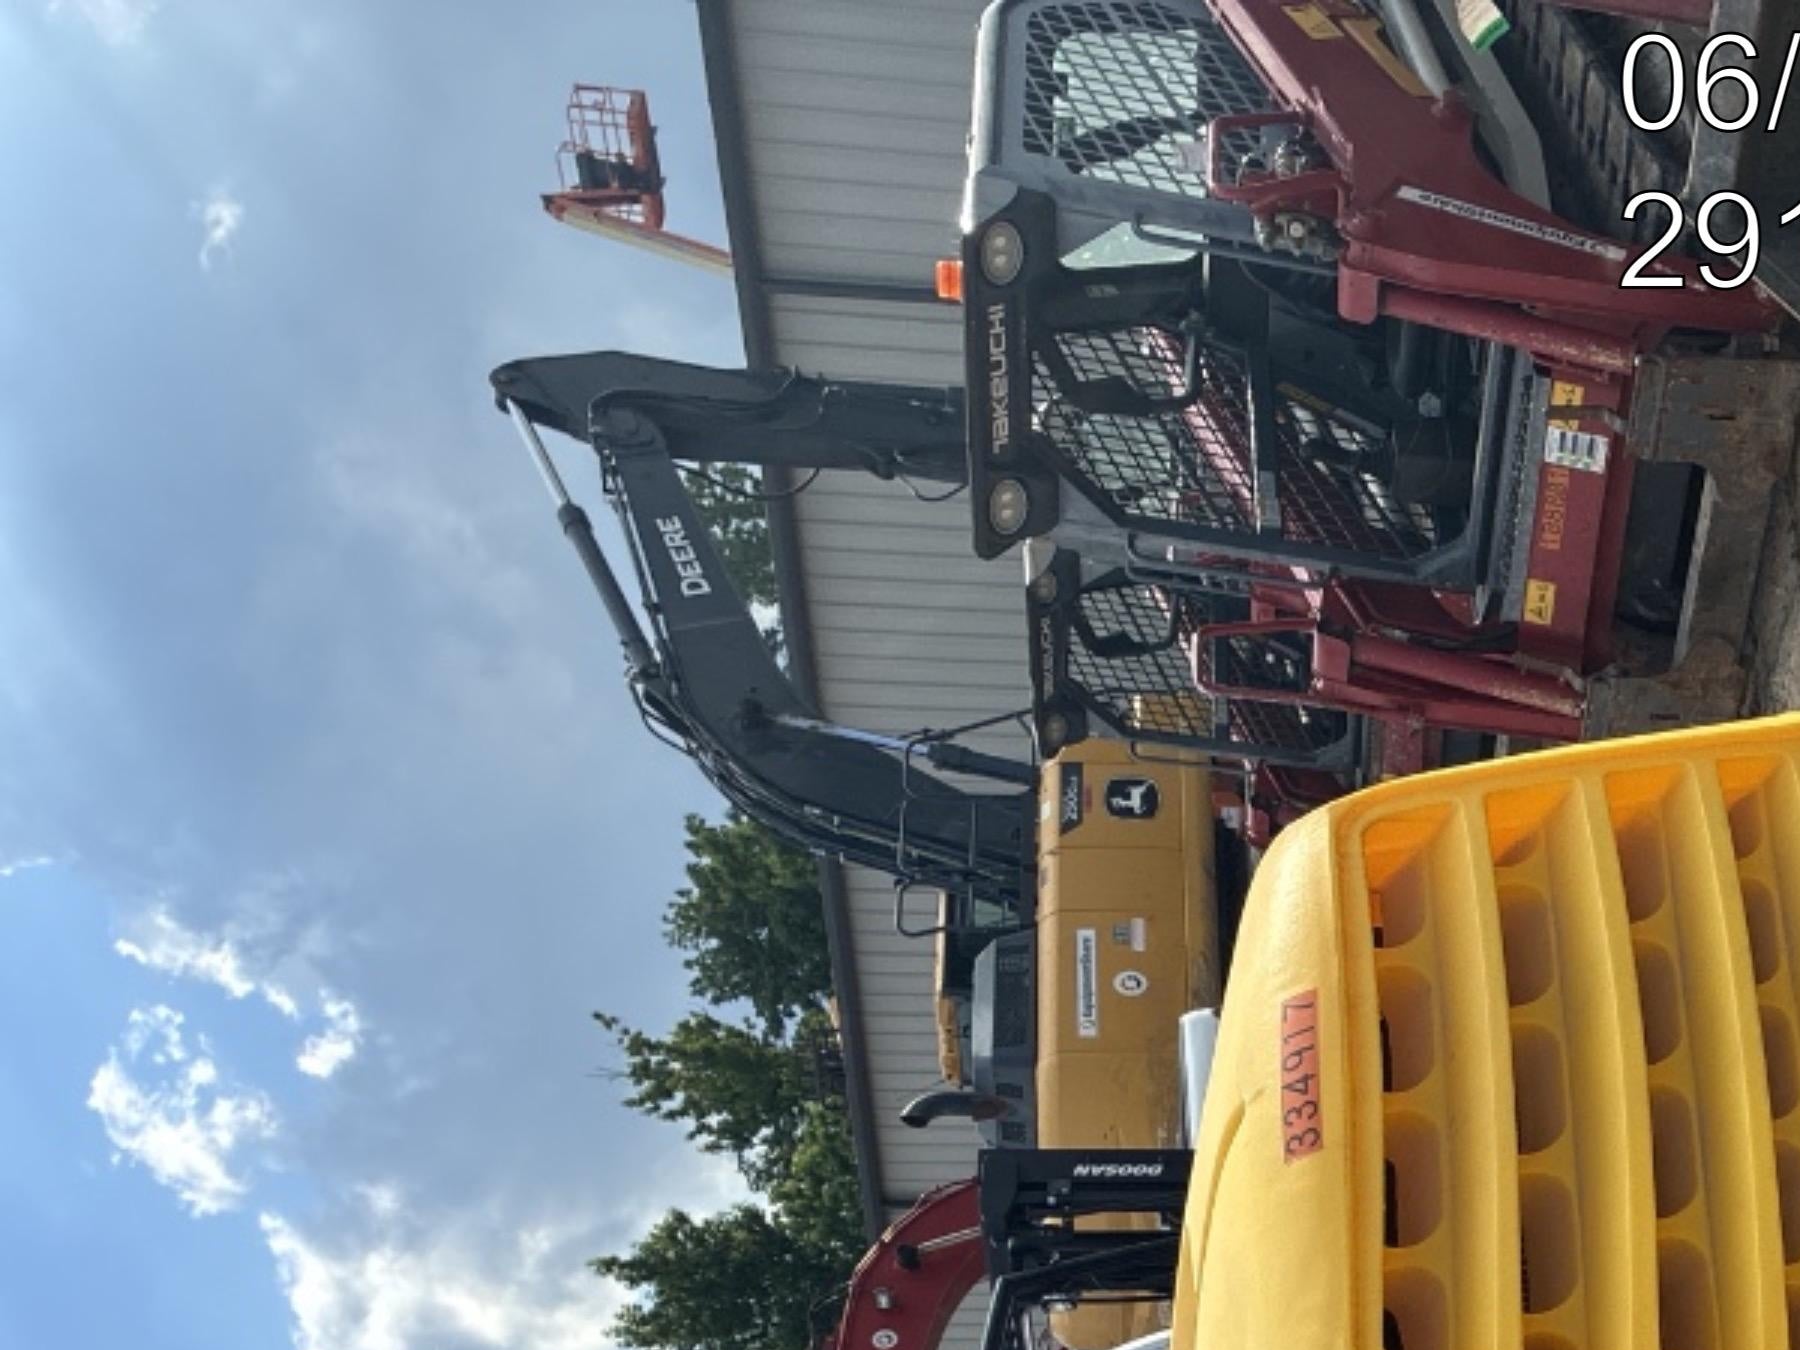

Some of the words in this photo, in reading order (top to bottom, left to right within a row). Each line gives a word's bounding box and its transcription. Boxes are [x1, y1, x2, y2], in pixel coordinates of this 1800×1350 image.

[655, 514, 712, 598] DEERE
[1279, 1000, 1321, 1155] 334917
[1072, 1162, 1165, 1178] DOOSAN
